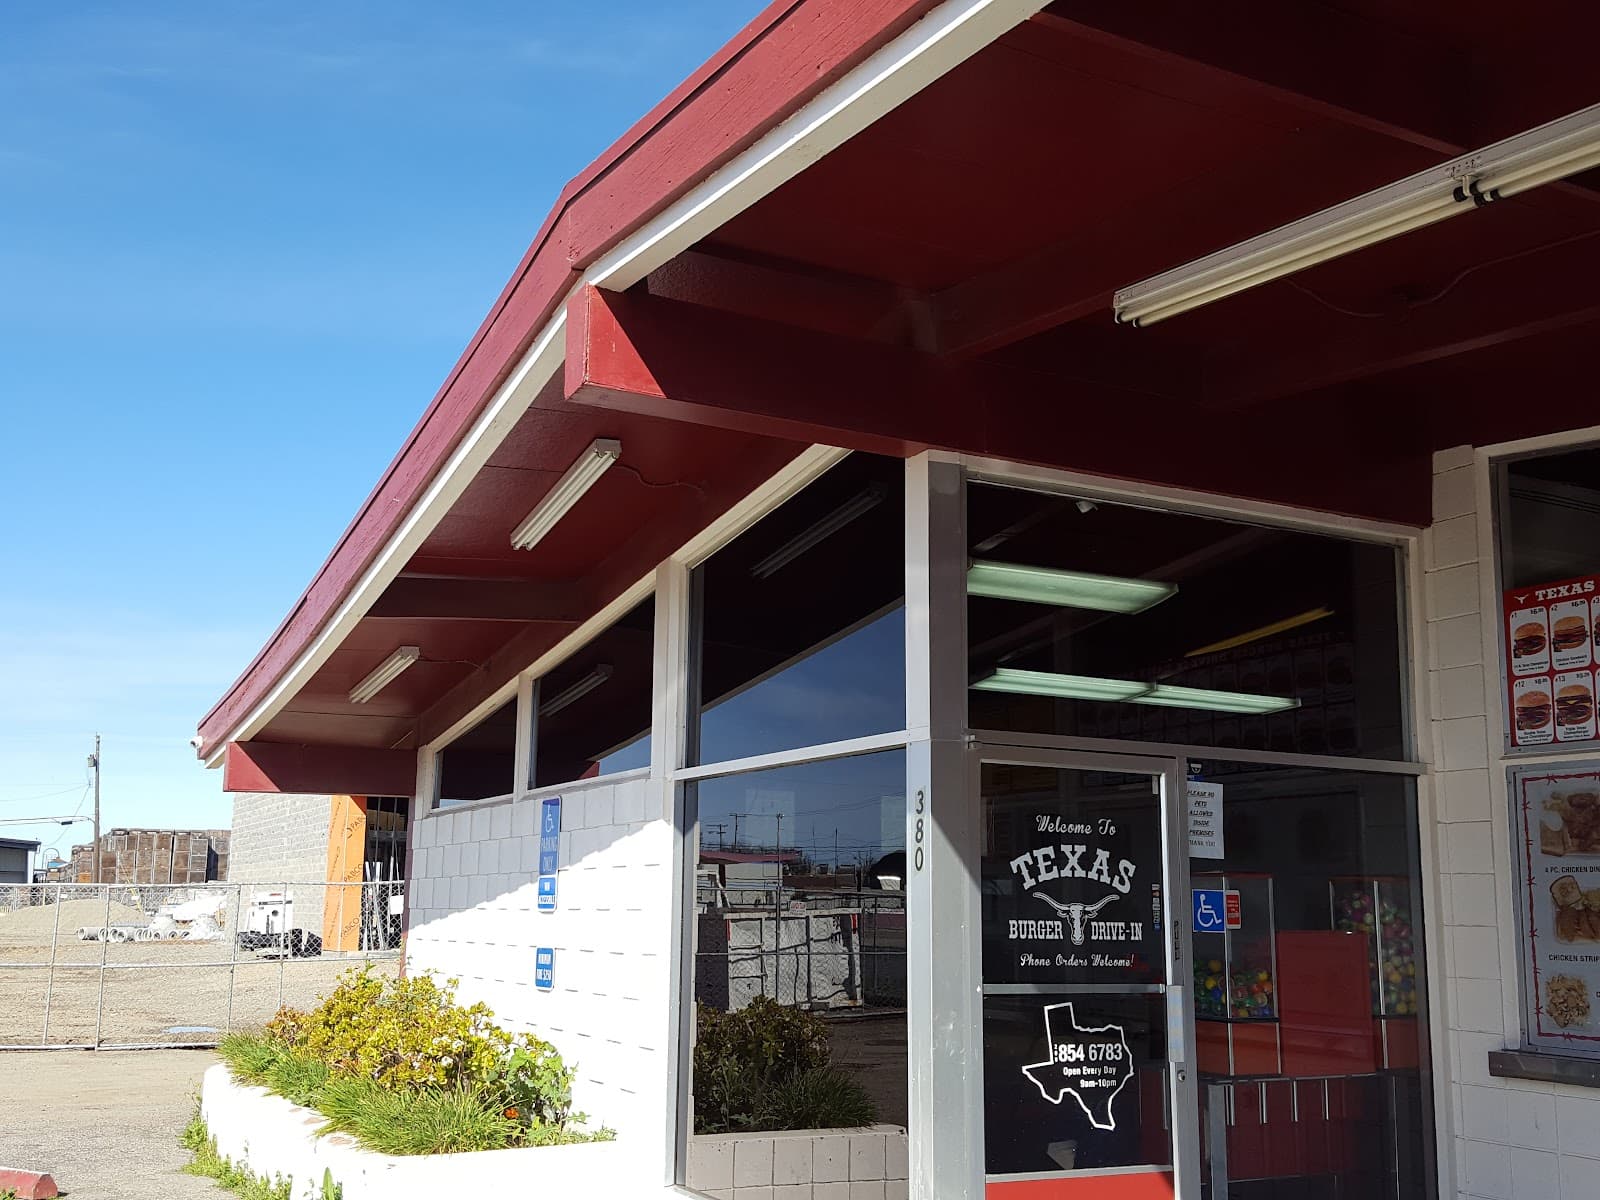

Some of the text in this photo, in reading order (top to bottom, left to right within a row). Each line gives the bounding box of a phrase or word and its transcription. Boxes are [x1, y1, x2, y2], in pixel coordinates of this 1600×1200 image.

[1535, 580, 1595, 601] TEXAS
[915, 790, 924, 872] 380
[1036, 814, 1116, 836] Welcome To
[1010, 844, 1136, 894] TEXAS
[1008, 920, 1143, 940] BURGER DRIVE-IN
[1020, 954, 1135, 967] Phone Orders Welcome!
[1059, 1044, 1085, 1062] 854
[1089, 1043, 1122, 1061] 6783
[1063, 1066, 1116, 1077] Open Every Day
[1080, 1079, 1116, 1088] 9am-10pm
